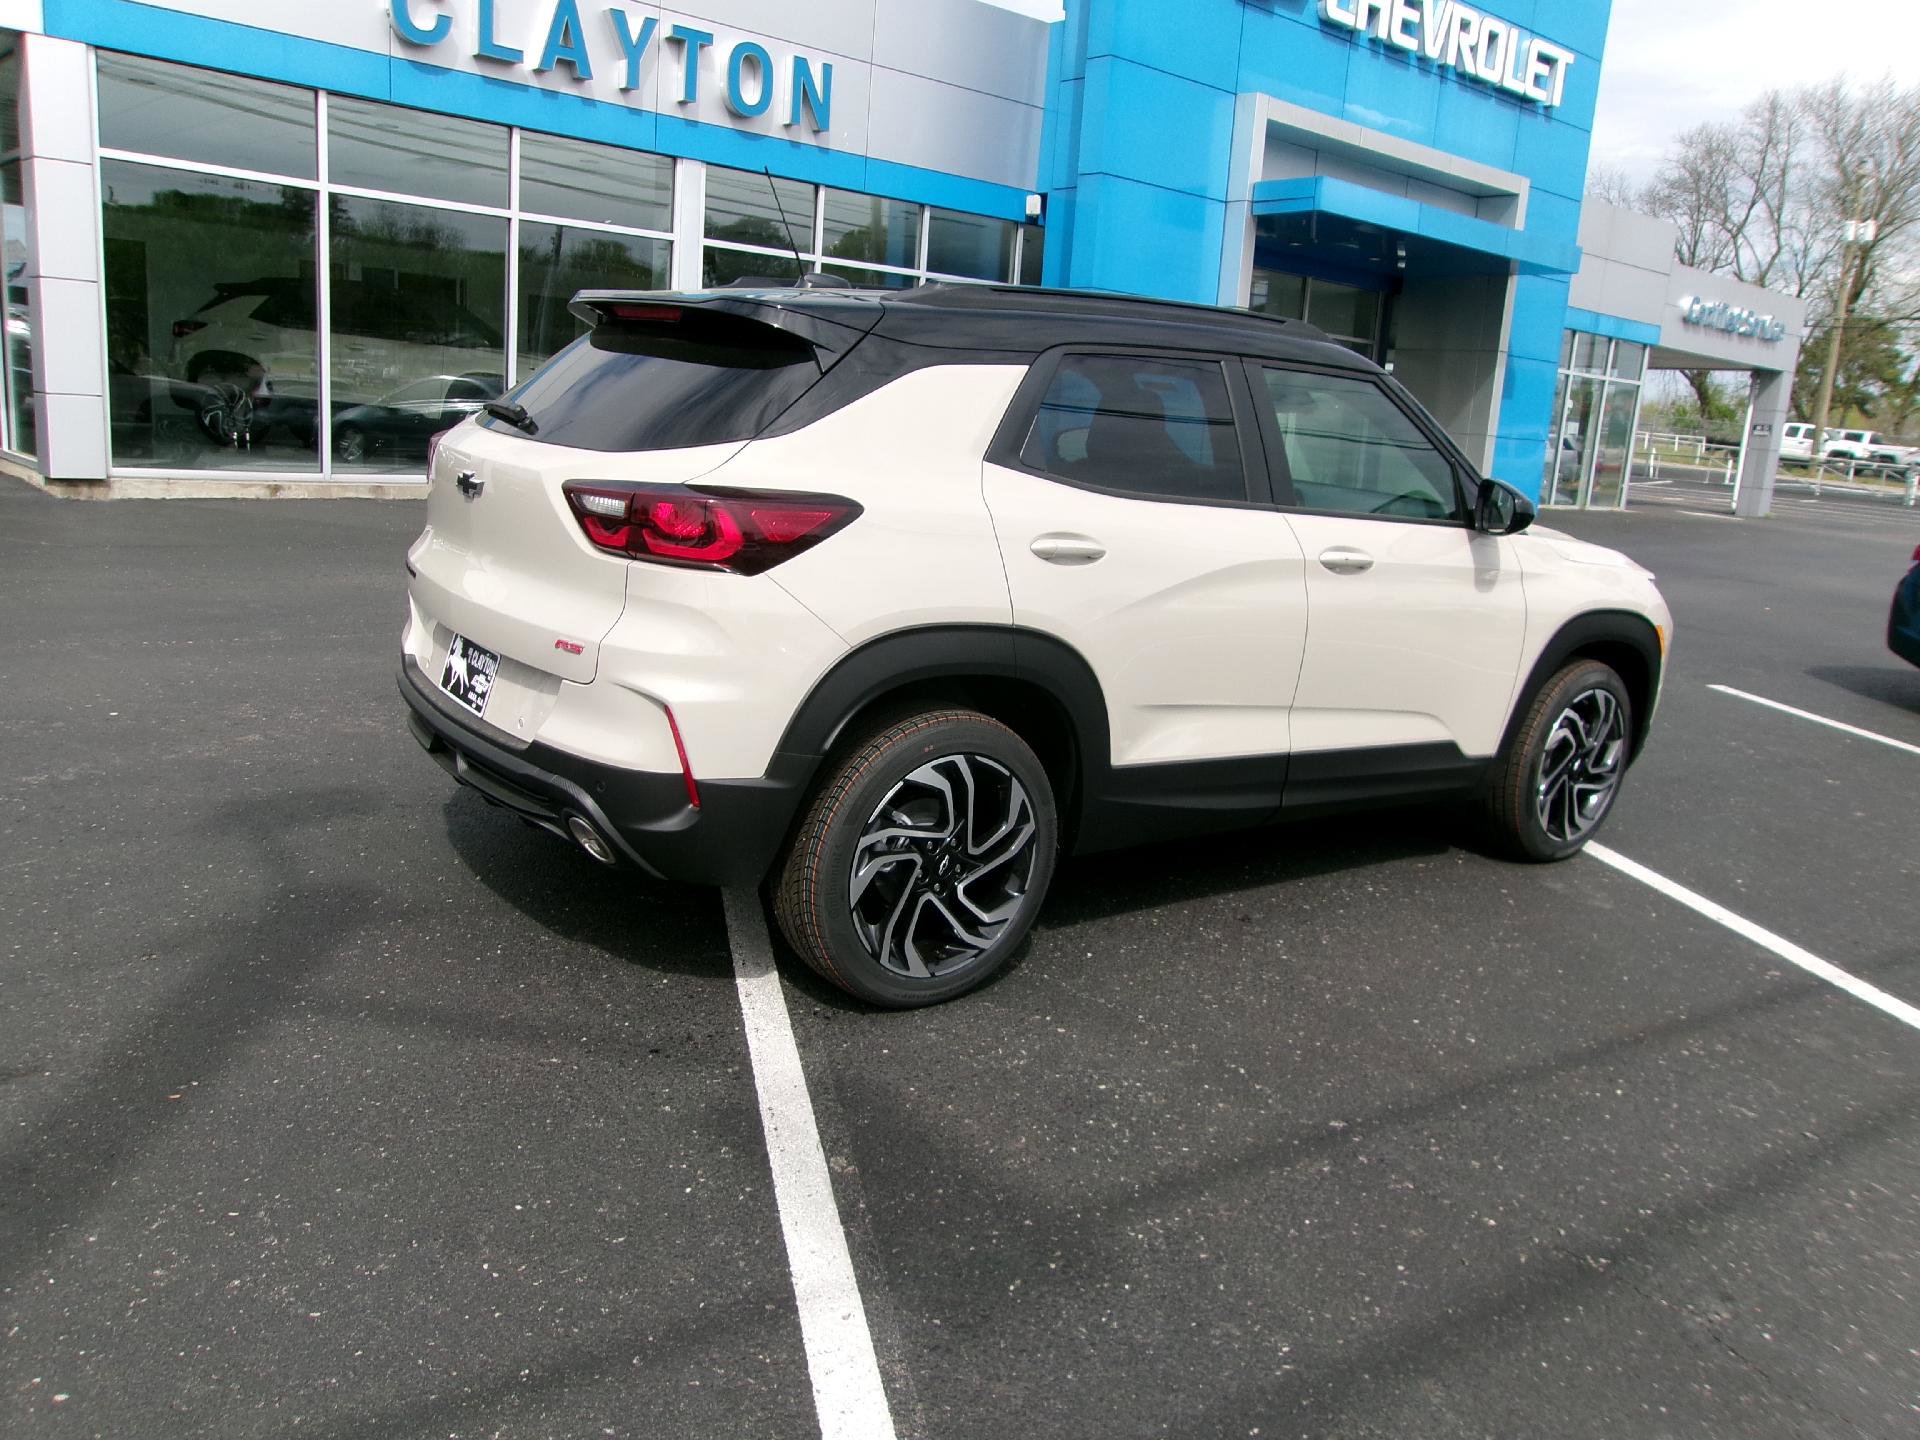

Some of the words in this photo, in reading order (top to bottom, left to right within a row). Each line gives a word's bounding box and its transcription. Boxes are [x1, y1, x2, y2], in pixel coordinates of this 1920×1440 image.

[390, 0, 834, 133] CLAYTON
[555, 639, 584, 655] RS
[470, 649, 497, 677] CLAYTON
